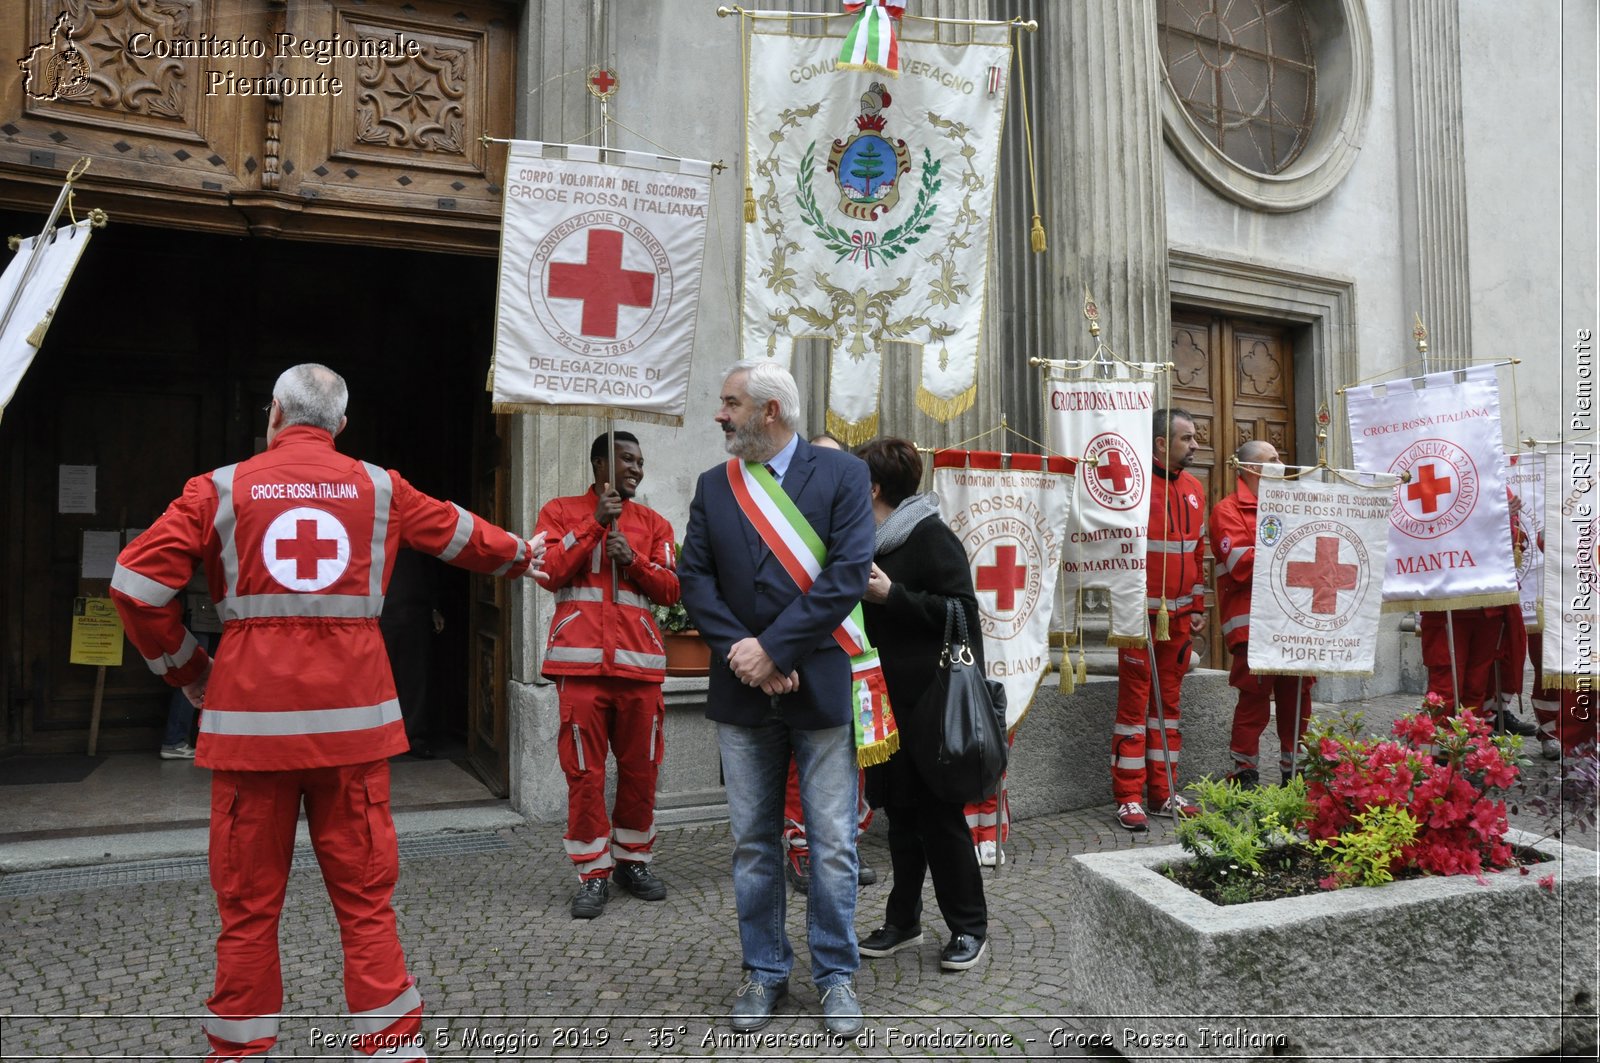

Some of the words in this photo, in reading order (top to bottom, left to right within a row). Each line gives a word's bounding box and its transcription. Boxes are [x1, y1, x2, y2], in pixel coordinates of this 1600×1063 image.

[900, 57, 974, 95] VERAGNO
[520, 168, 553, 183] CORPO
[560, 171, 616, 190] VOLONTARI
[621, 179, 641, 194] DEL
[646, 182, 697, 200] SOCCORSO
[508, 184, 568, 203] CROCE
[573, 190, 628, 210] ROSSA
[633, 198, 705, 219] ITALIANA
[535, 213, 613, 262] CONVENZIONE
[618, 216, 631, 229] DI
[633, 226, 670, 275] GINEVRA
[529, 356, 638, 379] DELEGAZIONE
[645, 367, 662, 381] DI
[533, 373, 653, 399] PEVERAGNO
[1363, 424, 1399, 437] CROCE
[1402, 417, 1434, 431] ROSSA
[1436, 408, 1489, 423] ITALIANA
[1096, 437, 1124, 449] GINEVRA
[1409, 442, 1454, 461] GINEVRA
[1397, 456, 1411, 471] DI
[1454, 456, 1469, 470] 22
[251, 483, 286, 500] CROCE
[286, 483, 318, 499] ROSSA
[319, 483, 359, 499] ITALIANA
[954, 473, 996, 488] VOLONTARI
[1000, 475, 1017, 488] DEL
[1021, 476, 1056, 490] SOCCORSO
[1455, 469, 1475, 514] AGOSTO
[1265, 489, 1291, 500] CORPO
[1292, 491, 1334, 503] VOLONTARI
[1337, 494, 1351, 505] DEL
[1353, 495, 1388, 507] SOCCORSO
[1260, 502, 1300, 514] CROCE
[1304, 506, 1343, 516] ROSSA
[1347, 508, 1390, 519] ITALIANA
[969, 495, 1024, 519] ROSSA
[1025, 501, 1058, 569] ITALIANA
[1436, 511, 1459, 532] 1864
[970, 531, 985, 546] DI
[988, 521, 1031, 545] GINEVRA
[1071, 527, 1132, 543] COMITATO
[1275, 522, 1333, 561] CONVENZIONE
[1335, 524, 1344, 532] DI
[1345, 529, 1368, 565] GINEVRA
[1121, 542, 1134, 554] DI
[1131, 558, 1146, 570] DE
[1395, 549, 1477, 575] MANTA
[1281, 646, 1352, 661] MORETTA
[987, 656, 1041, 677] IGLIANO
